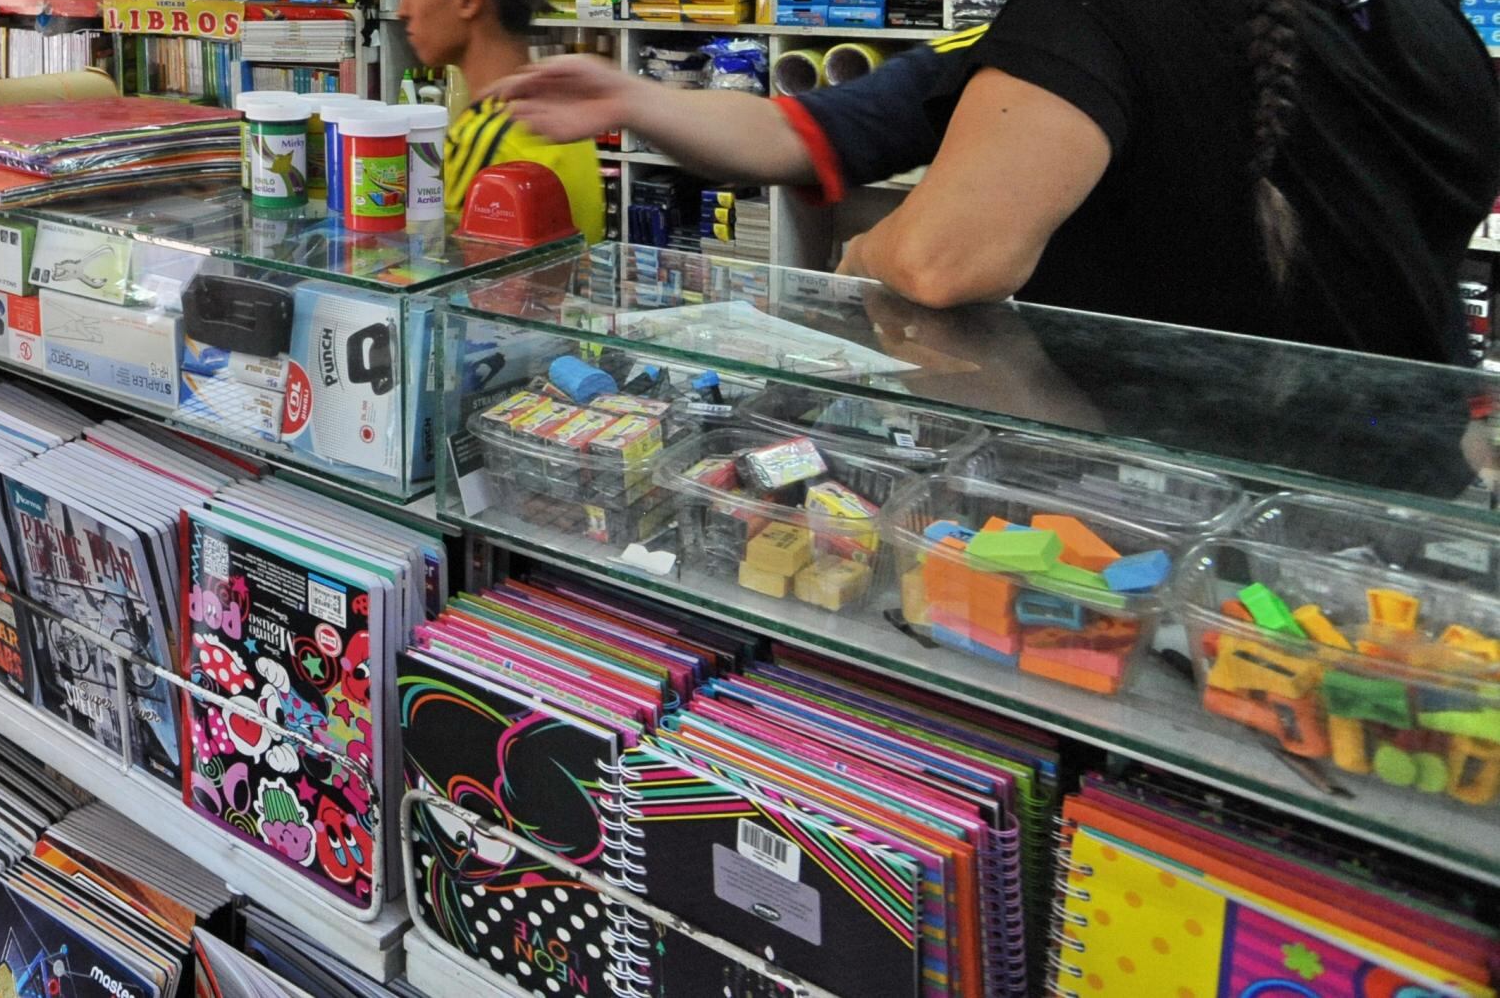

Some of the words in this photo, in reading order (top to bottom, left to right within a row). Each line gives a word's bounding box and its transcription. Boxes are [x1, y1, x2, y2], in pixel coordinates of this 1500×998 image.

[156, 0, 178, 8] VENTA
[108, 8, 241, 36] LIBROS
[254, 178, 276, 187] VINILO
[50, 351, 91, 377] kangaro
[131, 373, 172, 394] STAPLER
[19, 512, 87, 567] RACING
[83, 527, 142, 597] TEAM
[514, 918, 581, 970] LOVE
[514, 935, 590, 995] NEON
